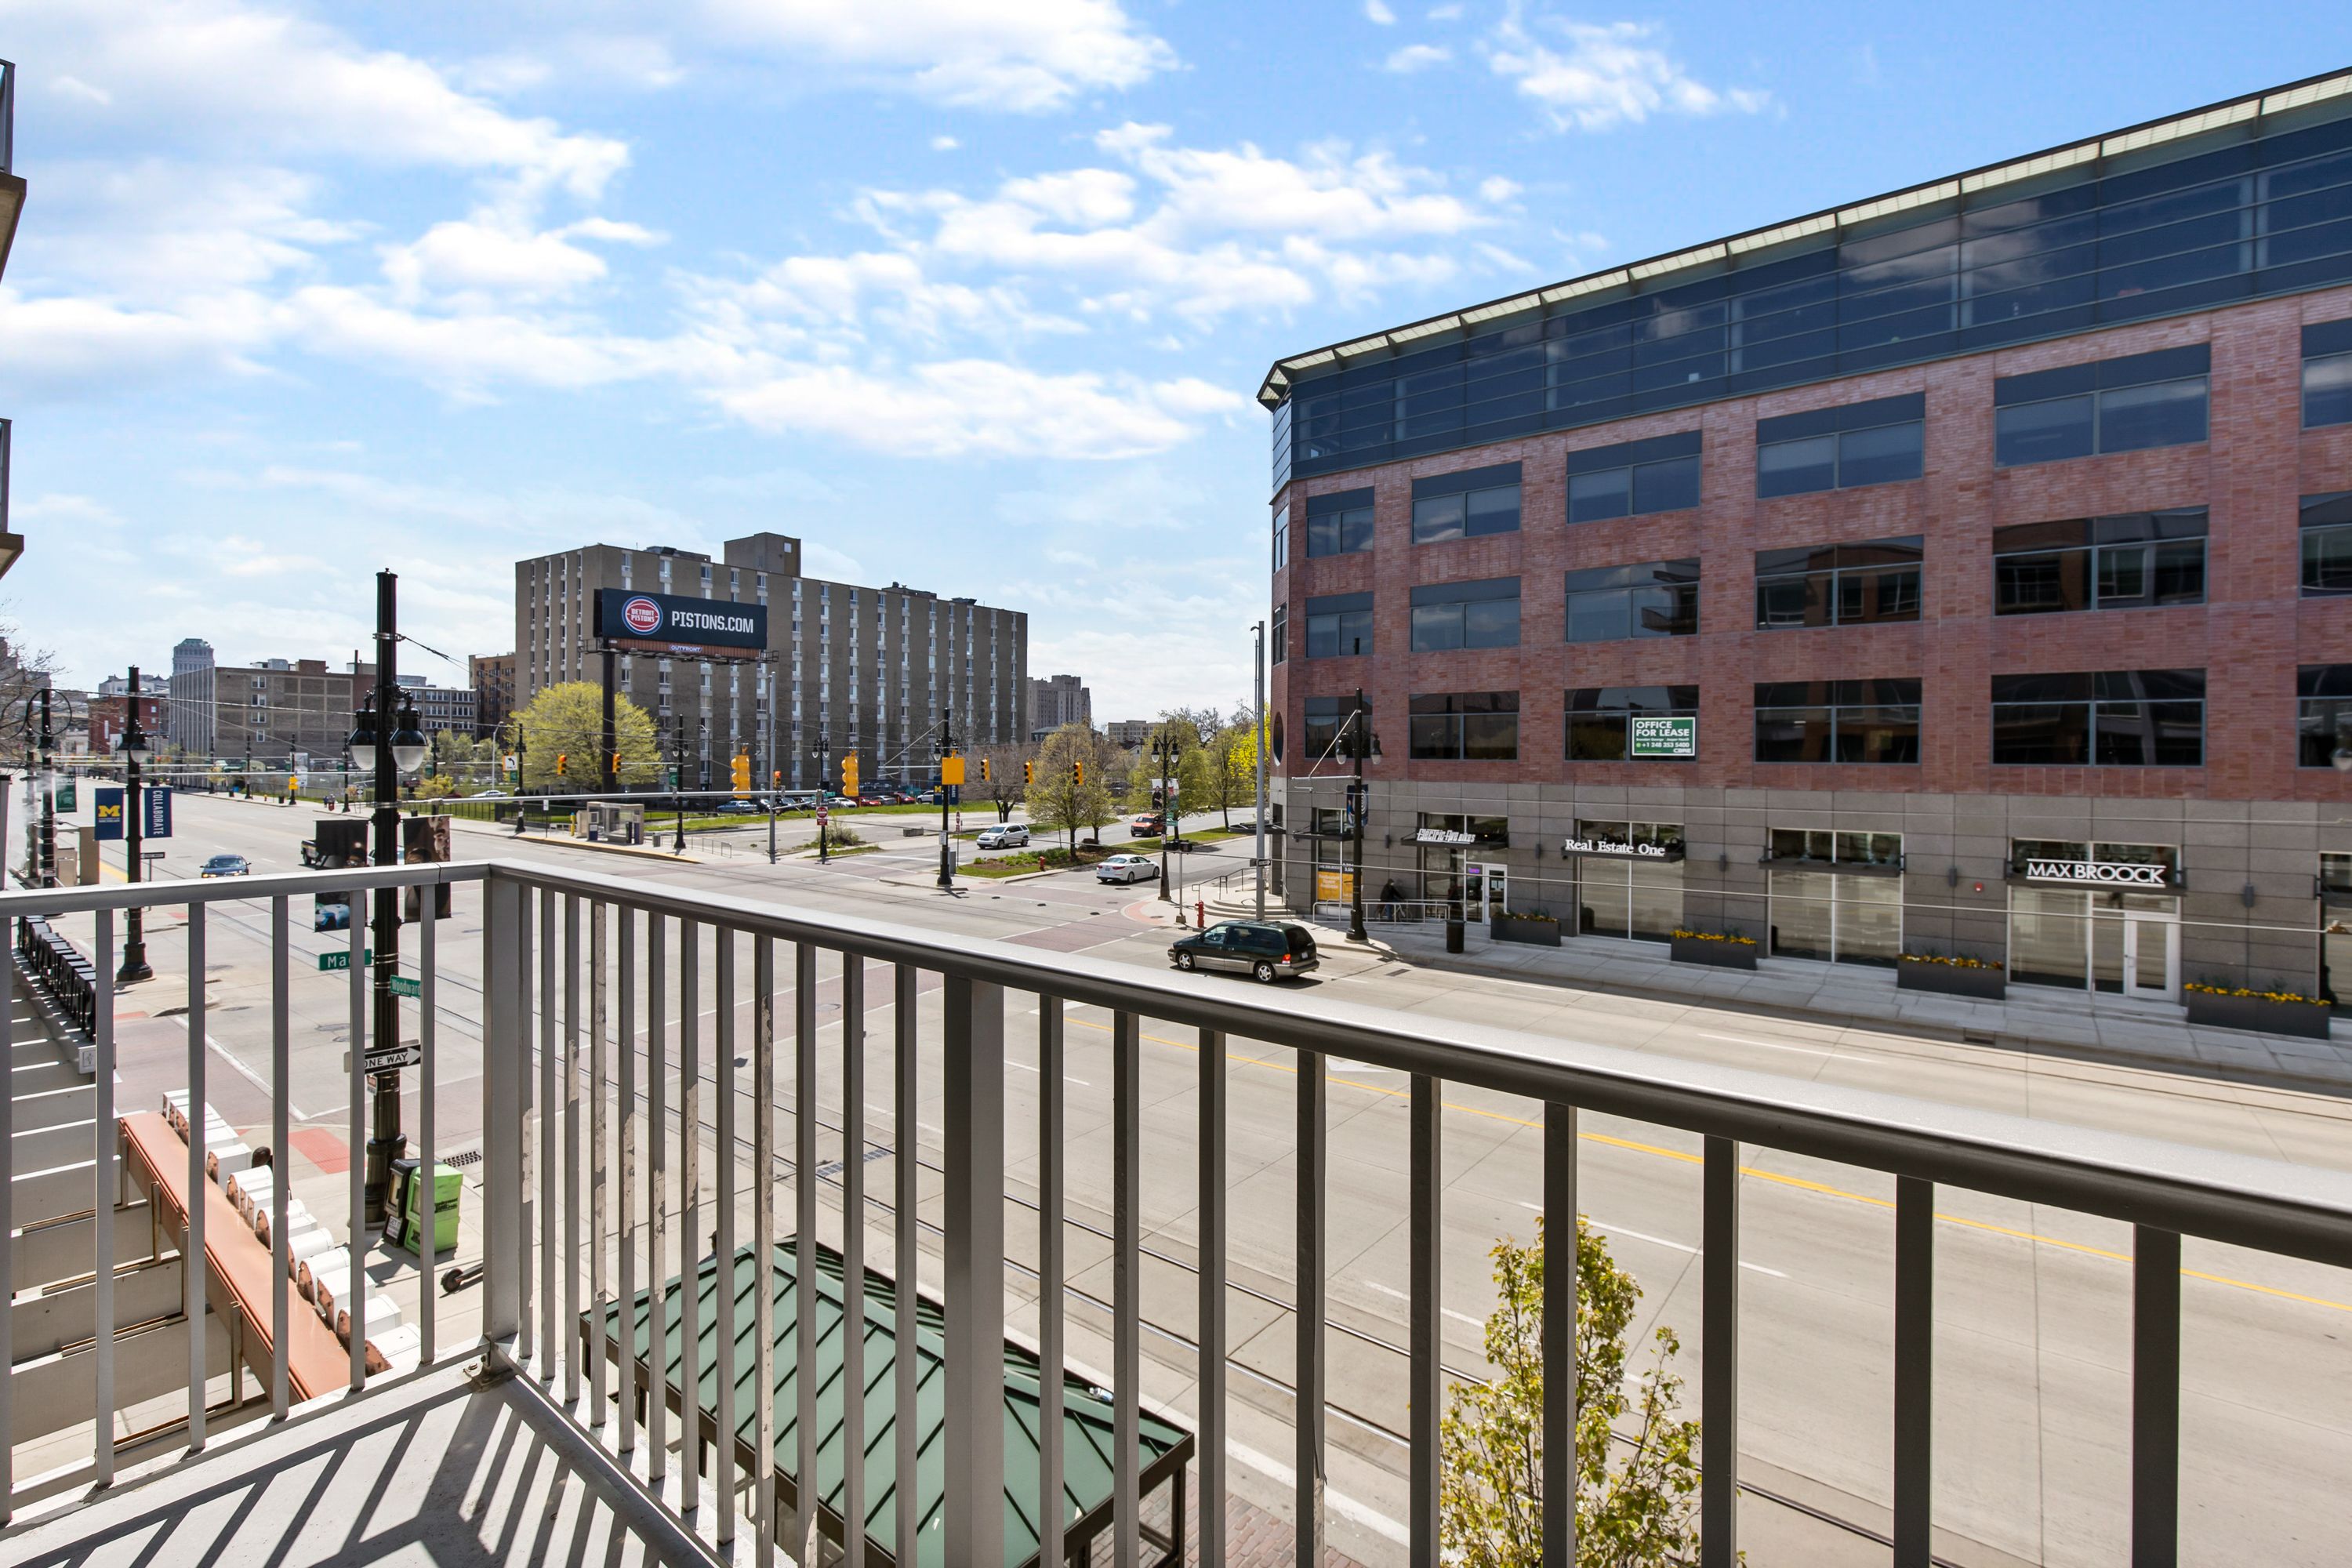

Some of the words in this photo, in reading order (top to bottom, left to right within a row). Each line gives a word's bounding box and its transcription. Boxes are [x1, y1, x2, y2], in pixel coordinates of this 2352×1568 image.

[672, 611, 753, 633] PISTONS.COM
[1660, 728, 1690, 737] LEASE
[98, 805, 121, 817] M
[152, 790, 164, 835] COLLABORATE
[1565, 839, 1593, 851] Real
[1597, 840, 1634, 853] Estate
[1638, 844, 1665, 855] One
[2027, 862, 2071, 878] MAX
[2074, 864, 2165, 884] BROOCK
[327, 956, 350, 968] Ma
[387, 1052, 408, 1064] WAY
